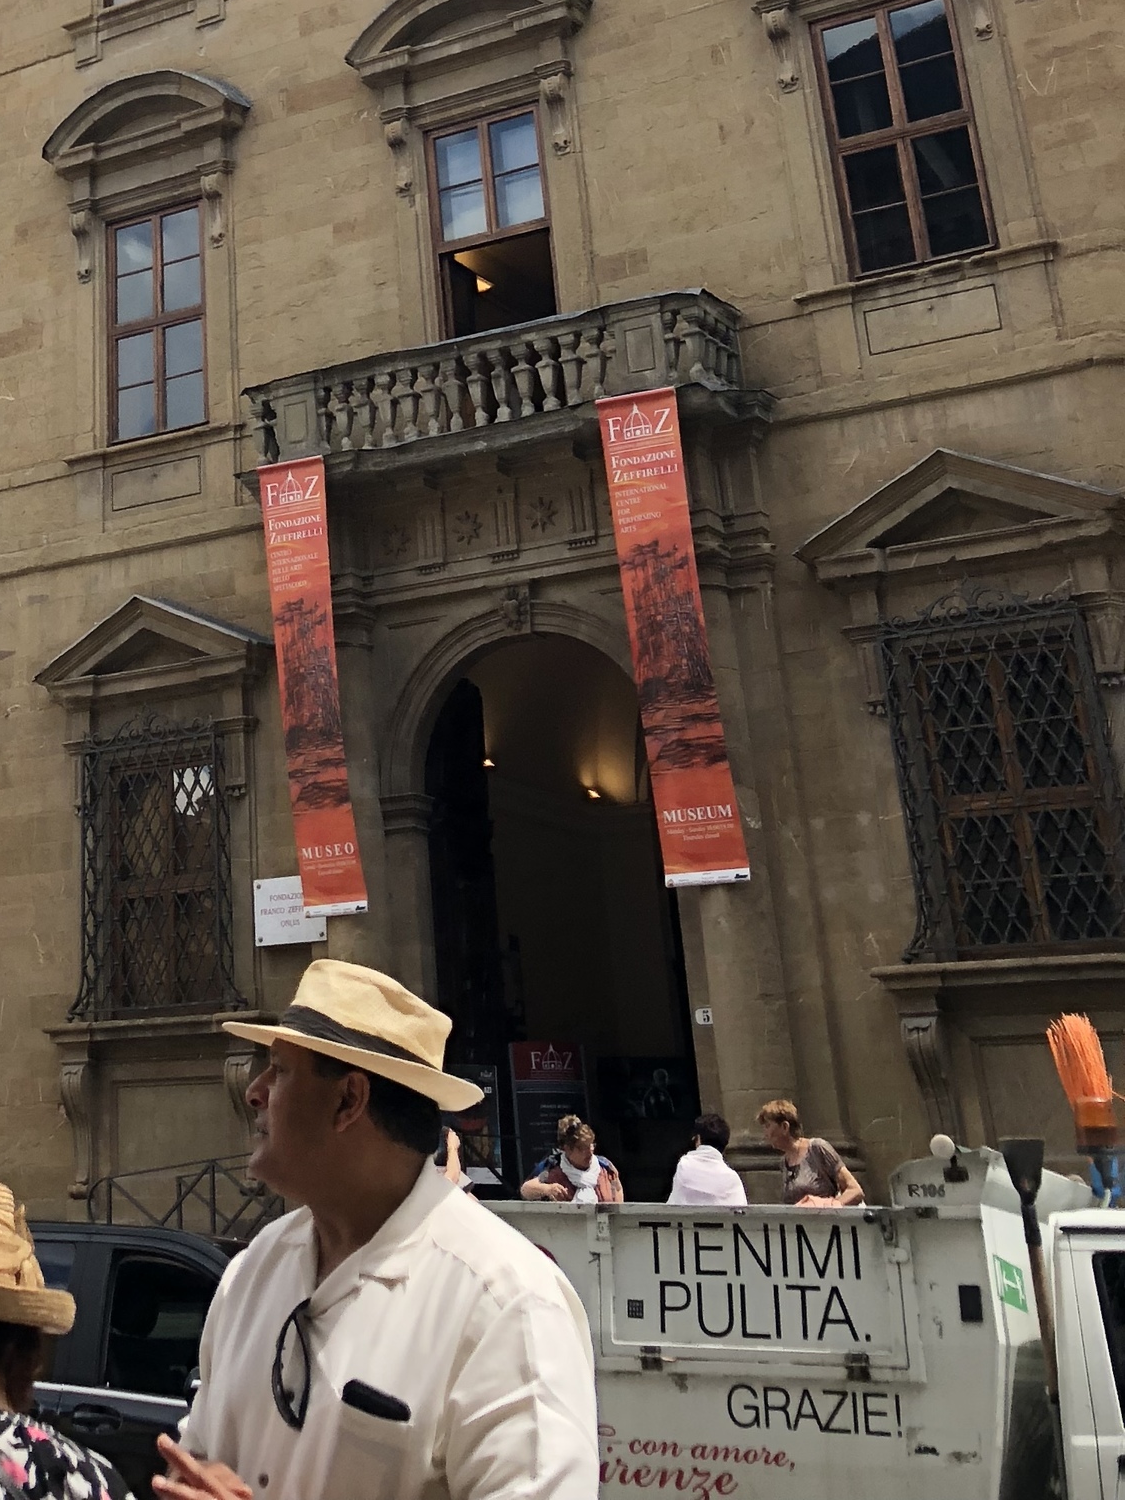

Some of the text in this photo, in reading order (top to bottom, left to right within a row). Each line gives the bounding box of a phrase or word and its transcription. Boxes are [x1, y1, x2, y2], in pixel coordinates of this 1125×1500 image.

[663, 805, 733, 824] MUSEUM
[302, 841, 355, 860] MUSEO
[907, 1183, 946, 1198] R106
[638, 1221, 861, 1280] TIENIMI
[659, 1281, 872, 1342] PULITA.
[726, 1384, 903, 1438] GRAZIE!
[598, 1426, 739, 1500] irenze
[629, 1436, 796, 1471] con amore,
